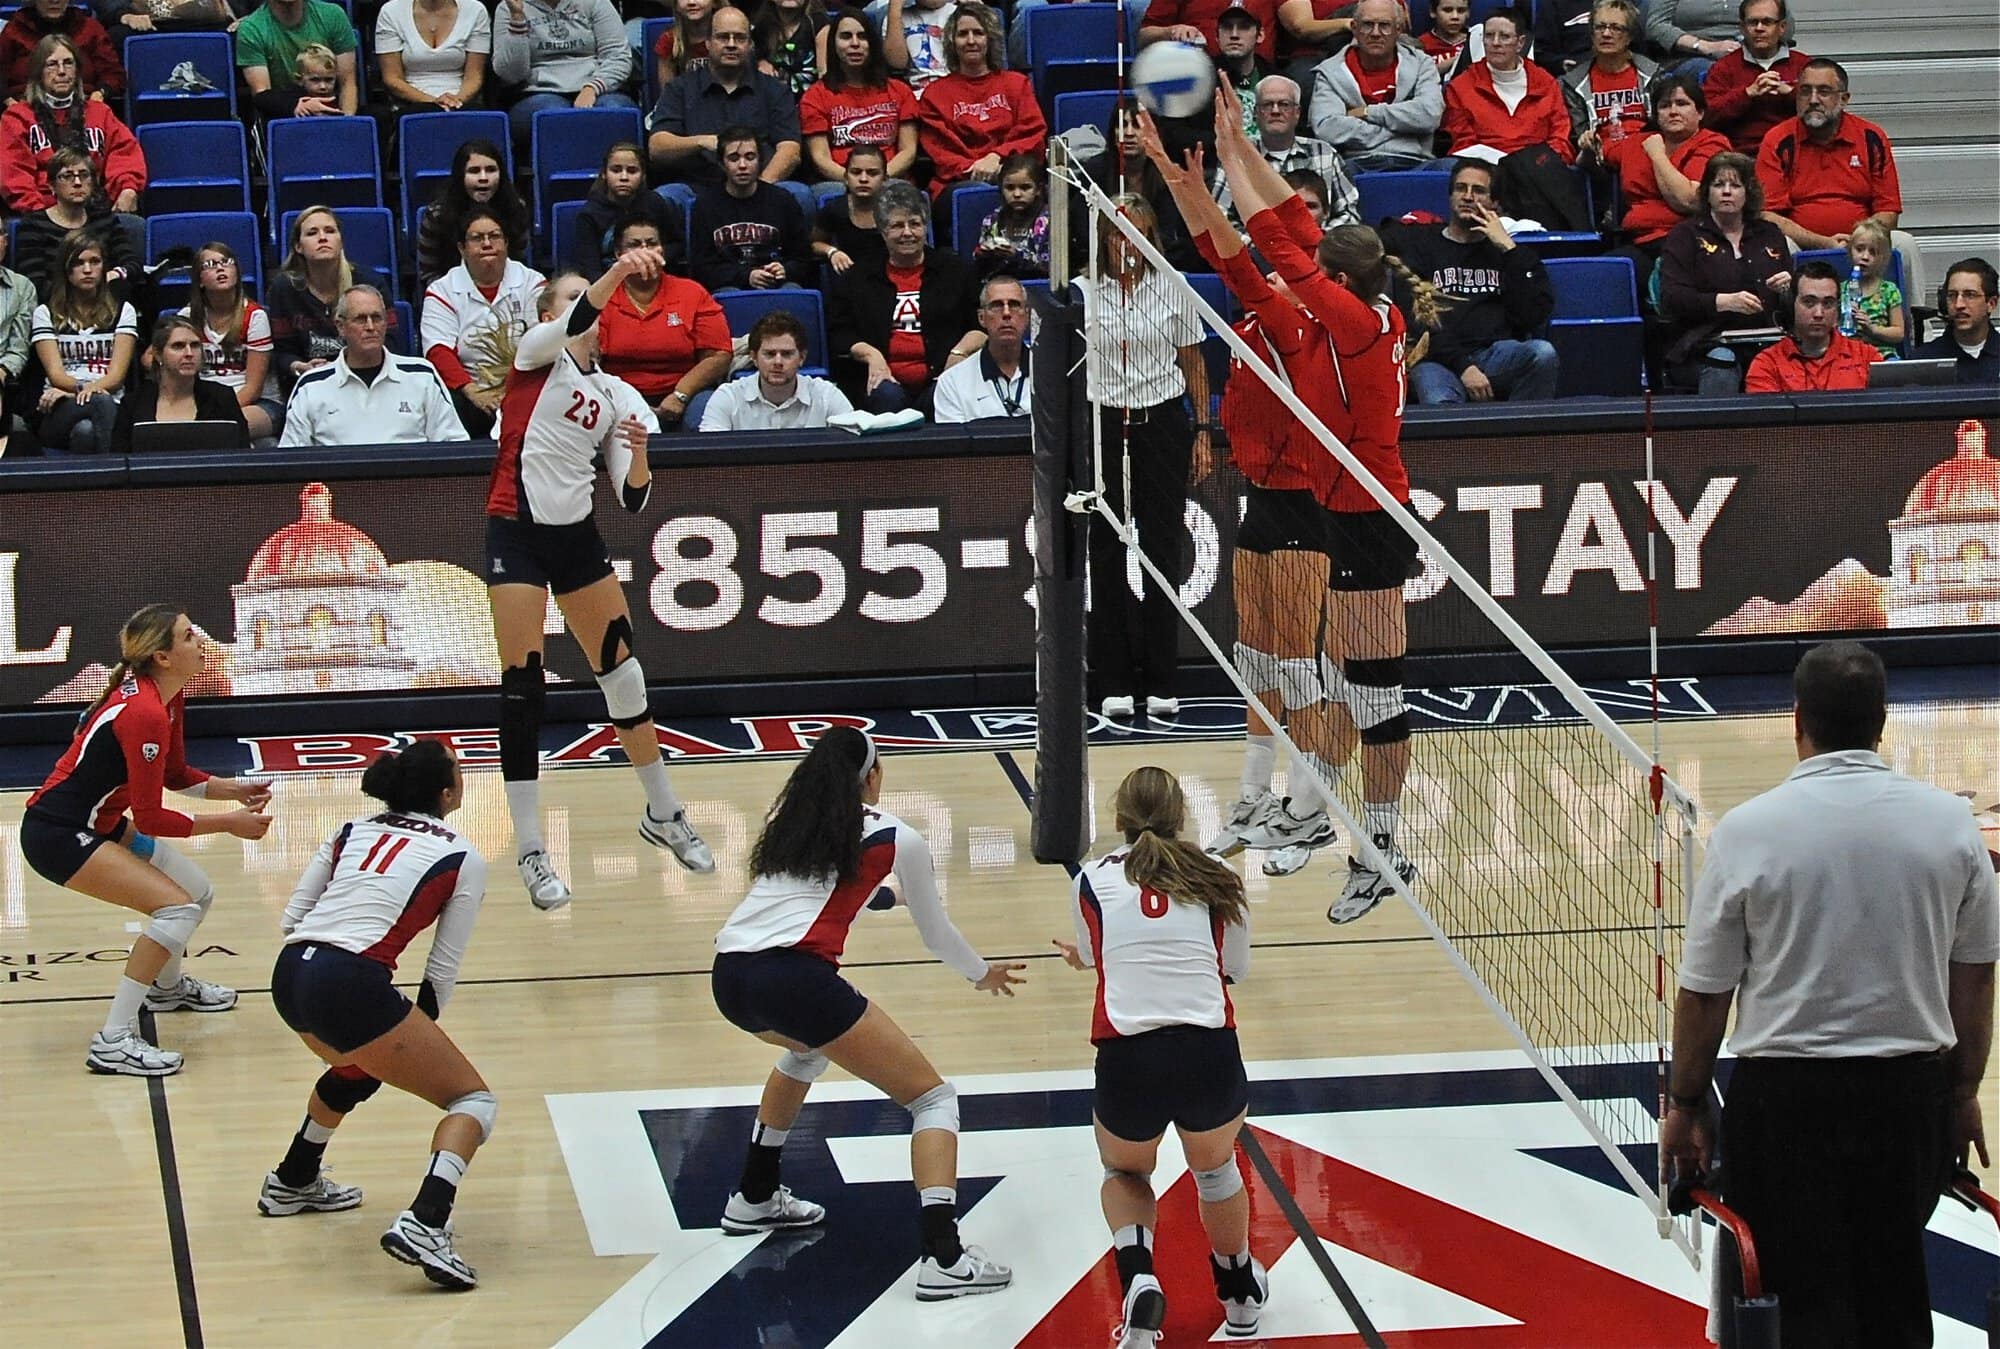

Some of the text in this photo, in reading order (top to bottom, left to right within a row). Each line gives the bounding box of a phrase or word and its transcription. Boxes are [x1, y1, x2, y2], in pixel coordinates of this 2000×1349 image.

[1432, 267, 1500, 289] ARIZON
[1442, 286, 1501, 294] WILDCAT
[564, 389, 600, 430] 23
[358, 832, 411, 875] 11
[0, 945, 240, 967] RIZOA
